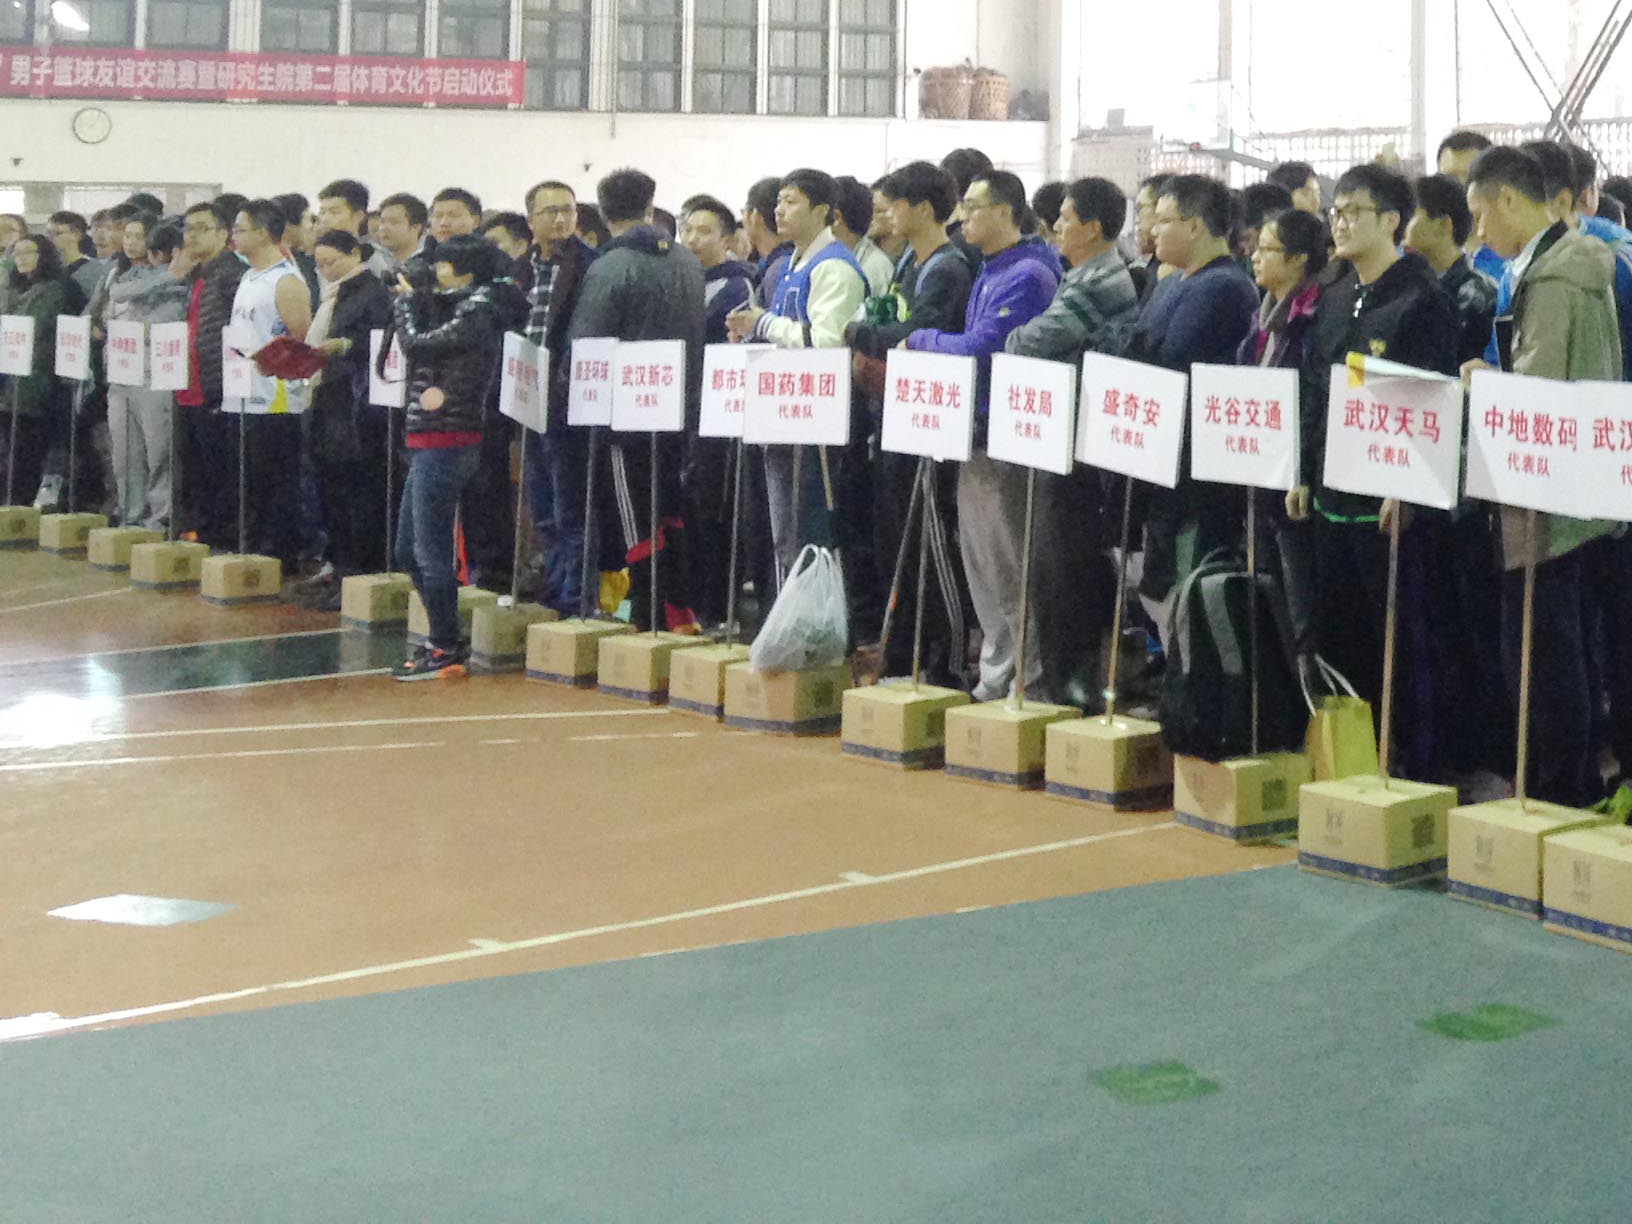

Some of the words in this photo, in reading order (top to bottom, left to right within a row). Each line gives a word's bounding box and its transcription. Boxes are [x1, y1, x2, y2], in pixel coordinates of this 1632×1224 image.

[0, 53, 514, 97] 男子篮球友谊交流赛暨研究生院第二届体育文化节启动仪式
[622, 364, 673, 387] 武汉新芯
[758, 371, 836, 397] 国药集团
[895, 378, 961, 409] 楚天激光
[1008, 383, 1053, 417] 社发局
[778, 404, 814, 419] 代表队
[1102, 388, 1160, 427] 盛奇安
[1205, 396, 1282, 432] 光谷交通
[912, 414, 940, 431] 代表队
[1014, 421, 1042, 441] 代表队
[1344, 399, 1441, 442] 武汉天马
[1484, 404, 1578, 452] 中地数码
[1110, 426, 1145, 449] 代表队
[1225, 436, 1260, 455] 代表队
[1370, 444, 1409, 465] 代表队
[1508, 452, 1550, 477] 代表队
